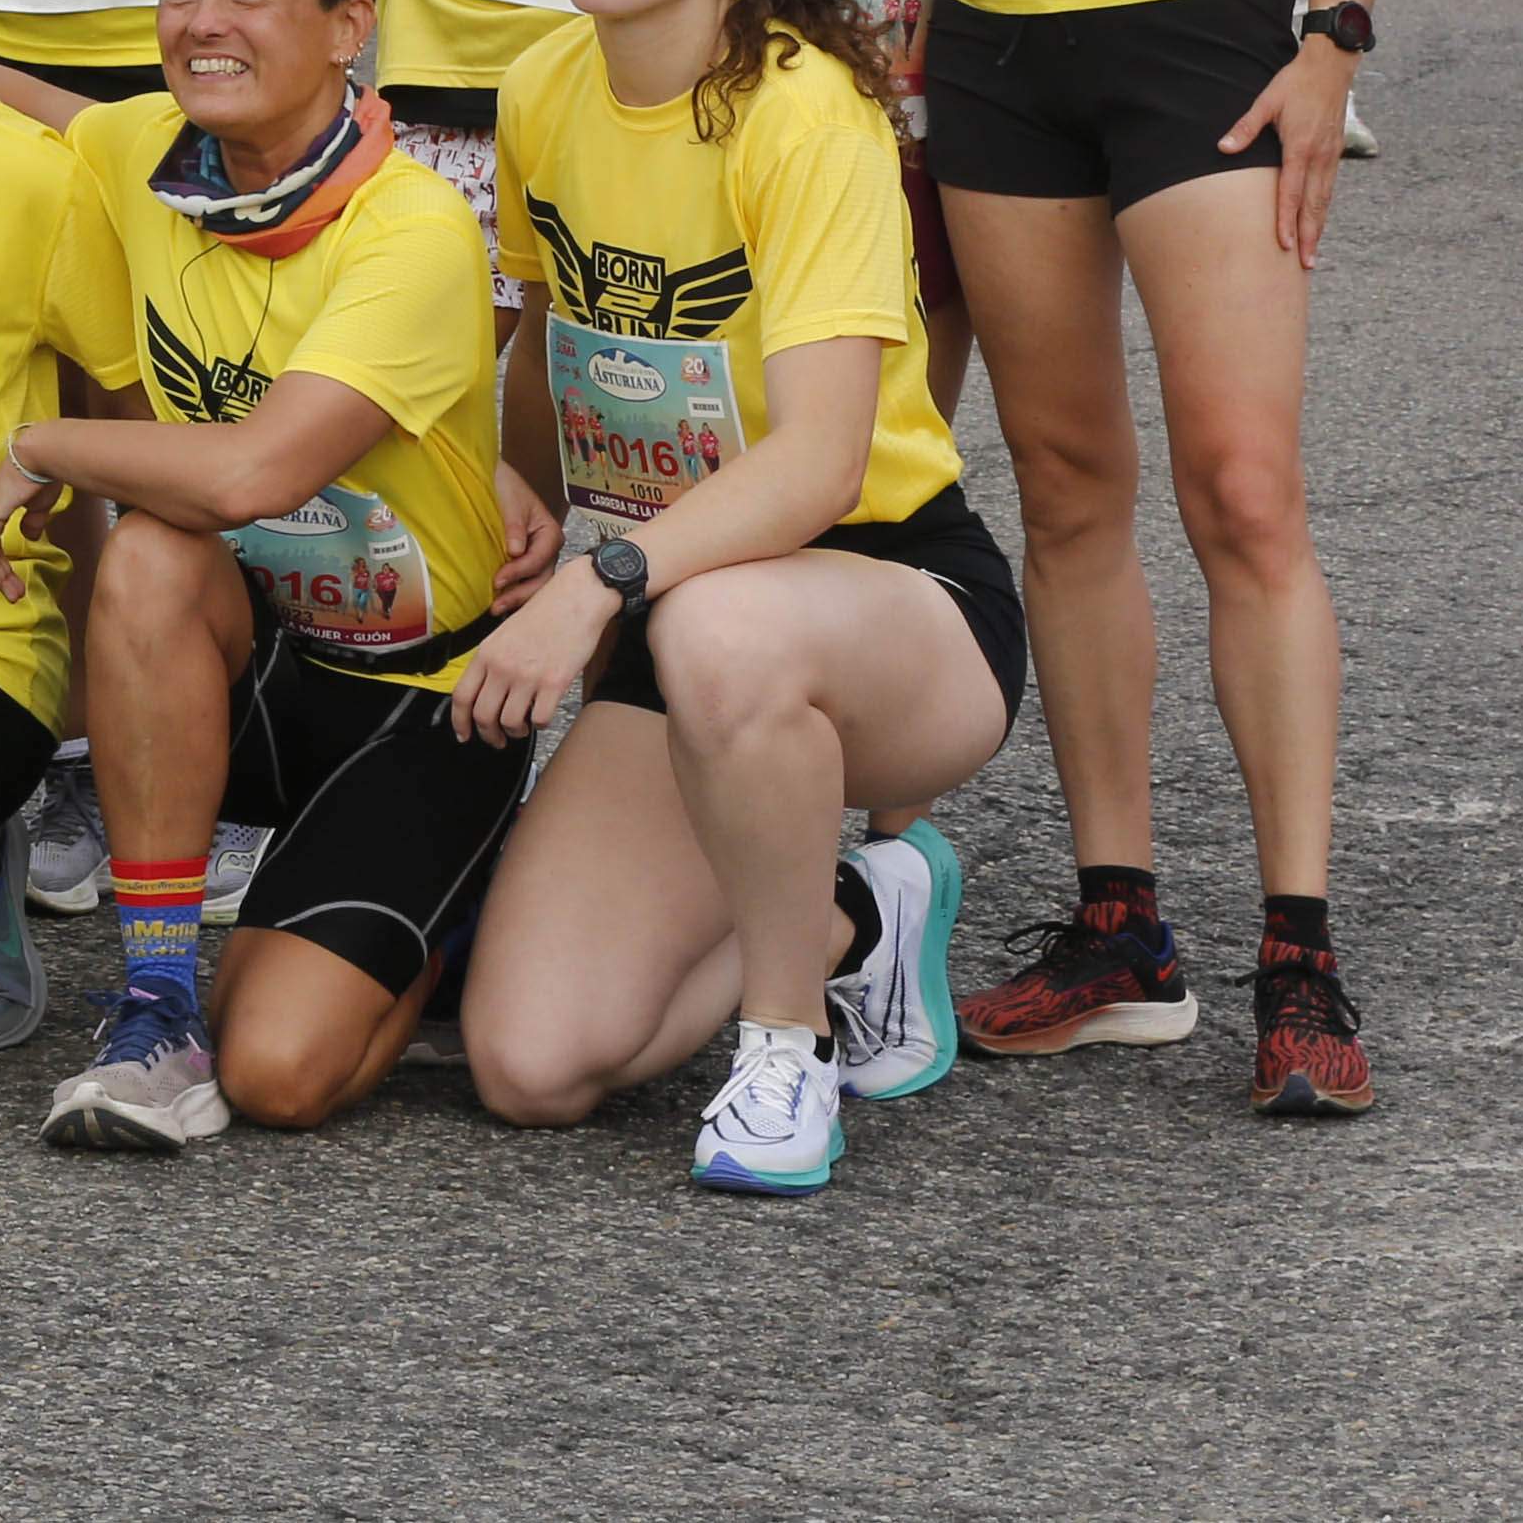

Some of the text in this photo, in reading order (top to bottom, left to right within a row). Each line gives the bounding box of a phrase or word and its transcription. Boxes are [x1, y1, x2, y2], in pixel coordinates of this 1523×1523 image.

[598, 255, 659, 291] BORN
[593, 361, 662, 393] ASTURIANA
[682, 358, 705, 374] 20
[608, 433, 679, 477] 016
[589, 492, 653, 518] CARRERA DE LA
[630, 483, 663, 503] 1010
[300, 626, 392, 643] MUJER GIJÓN
